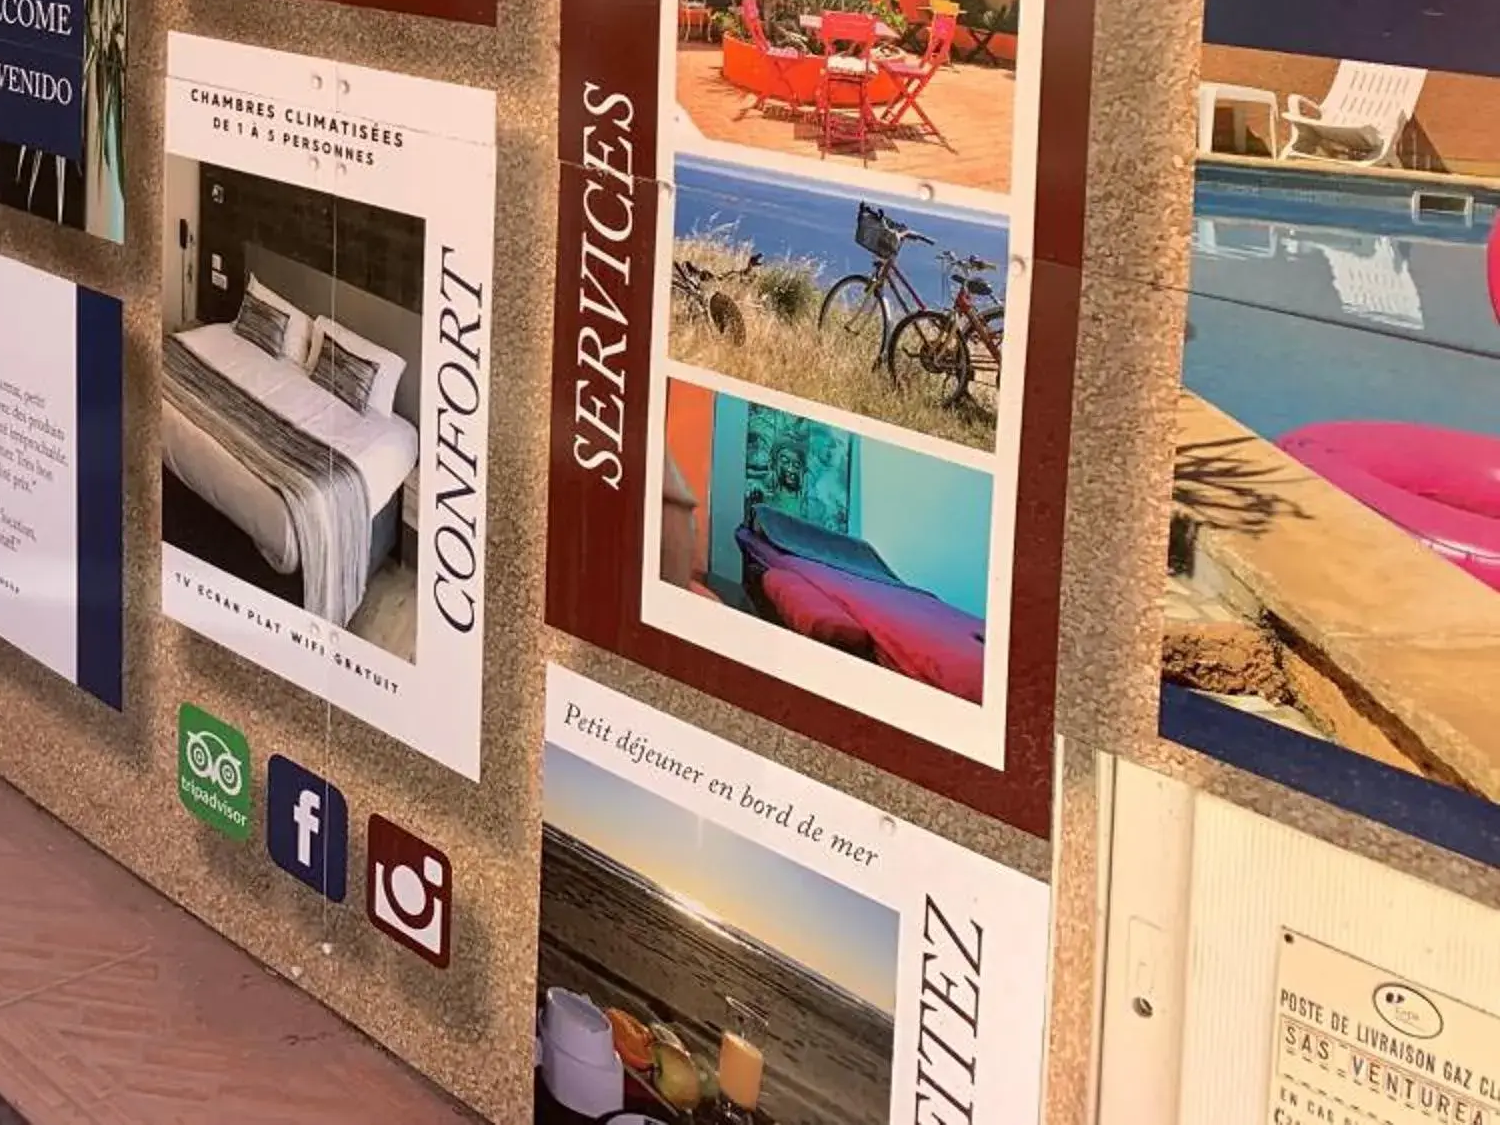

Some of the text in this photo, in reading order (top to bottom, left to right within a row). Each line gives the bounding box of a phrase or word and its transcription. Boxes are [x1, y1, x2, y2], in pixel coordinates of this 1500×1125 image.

[191, 88, 404, 148] CHAMBRES CLIMATISÉES
[213, 116, 229, 132] DE
[237, 122, 243, 135] 1
[267, 129, 275, 142] 5
[283, 133, 374, 166] PERSONNES
[574, 82, 634, 490] SERVICES
[433, 246, 483, 634] CONFORT
[174, 572, 399, 695] TV ECRAN PLAT WIFI GRATUIT
[181, 776, 248, 828] tripadvisor
[564, 703, 879, 867] Petit déjeuner en bord de mer
[1280, 988, 1324, 1025] POSTE
[1331, 1011, 1349, 1035] DE
[1357, 1021, 1437, 1075] LIVRAISON
[1443, 1060, 1474, 1092] GAZ
[1285, 1026, 1330, 1060] SAS
